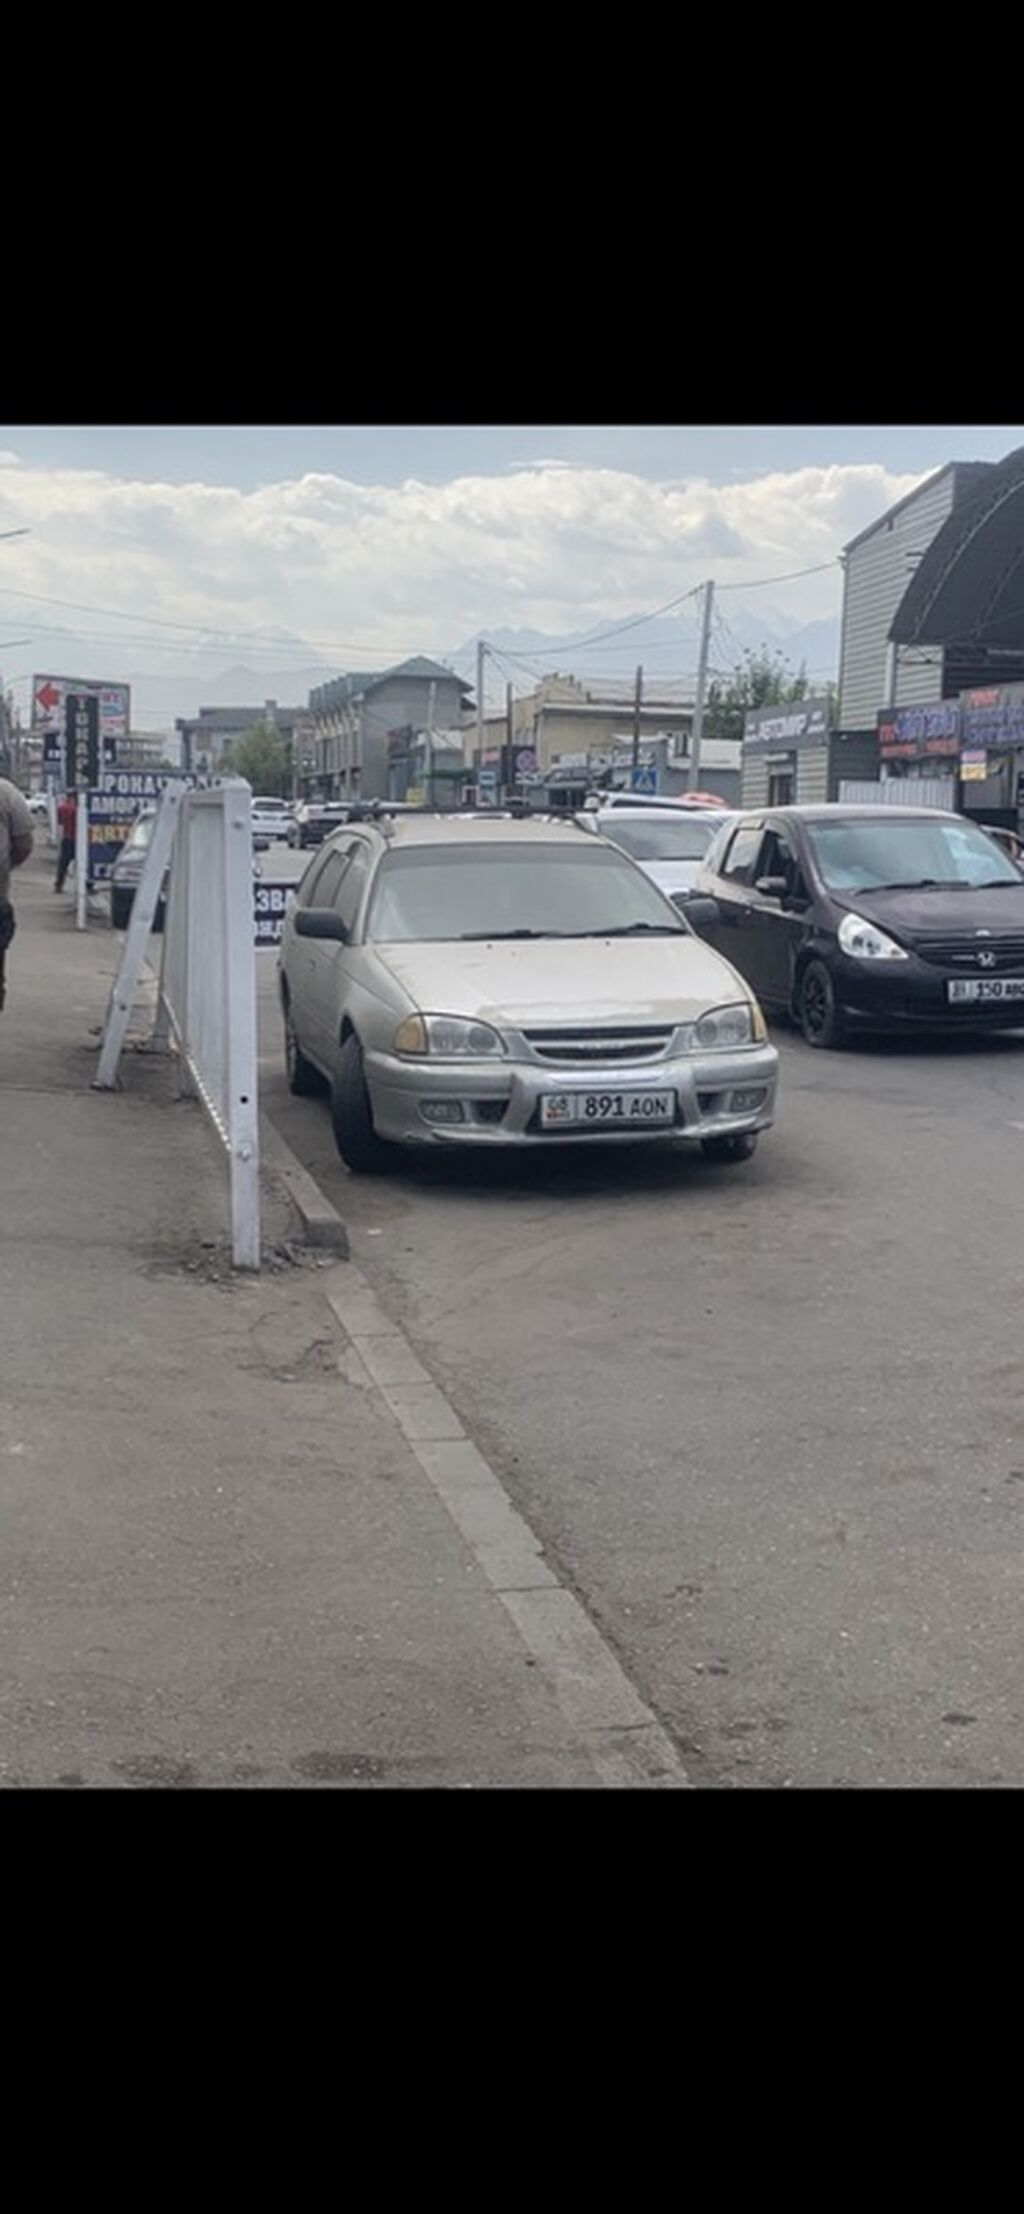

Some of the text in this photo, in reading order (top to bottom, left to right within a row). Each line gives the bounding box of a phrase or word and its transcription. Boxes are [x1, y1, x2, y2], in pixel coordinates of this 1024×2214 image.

[74, 696, 90, 785] ТОКАРЬ
[584, 1096, 624, 1117] 891
[630, 1097, 668, 1116] AON
